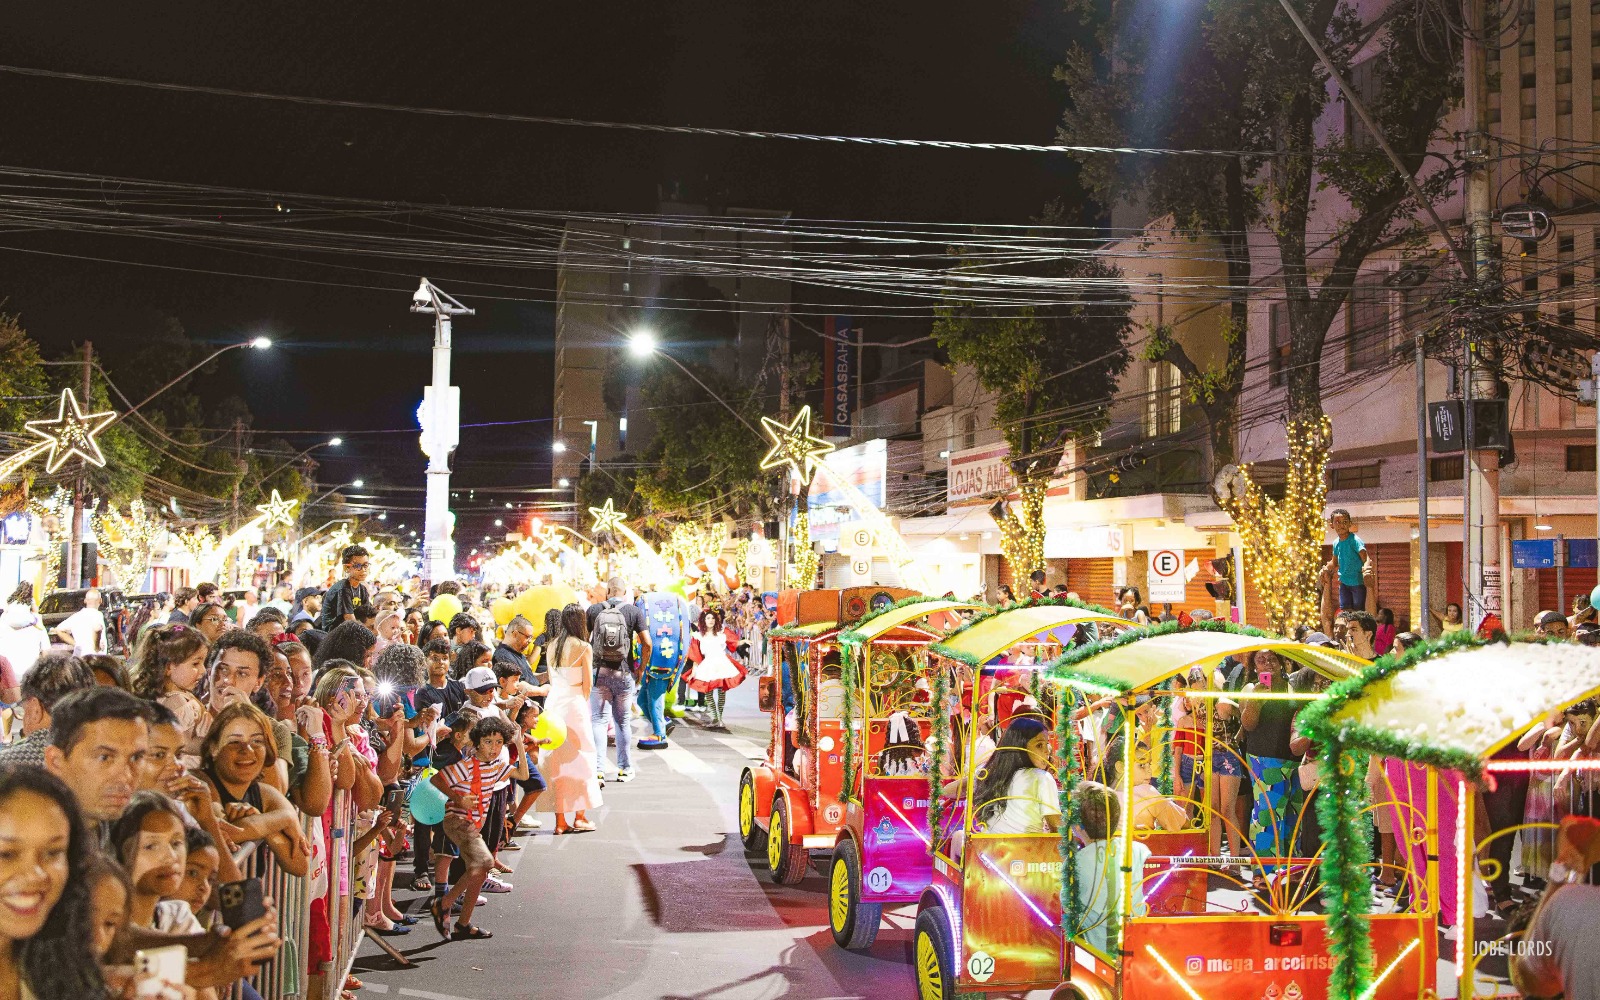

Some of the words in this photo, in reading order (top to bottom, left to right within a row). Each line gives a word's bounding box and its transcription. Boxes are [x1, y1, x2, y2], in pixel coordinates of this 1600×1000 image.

[951, 466, 983, 496] LOJAS
[1162, 556, 1171, 571] E
[828, 811, 839, 819] 10
[870, 872, 888, 887] 01
[971, 957, 994, 975] 02
